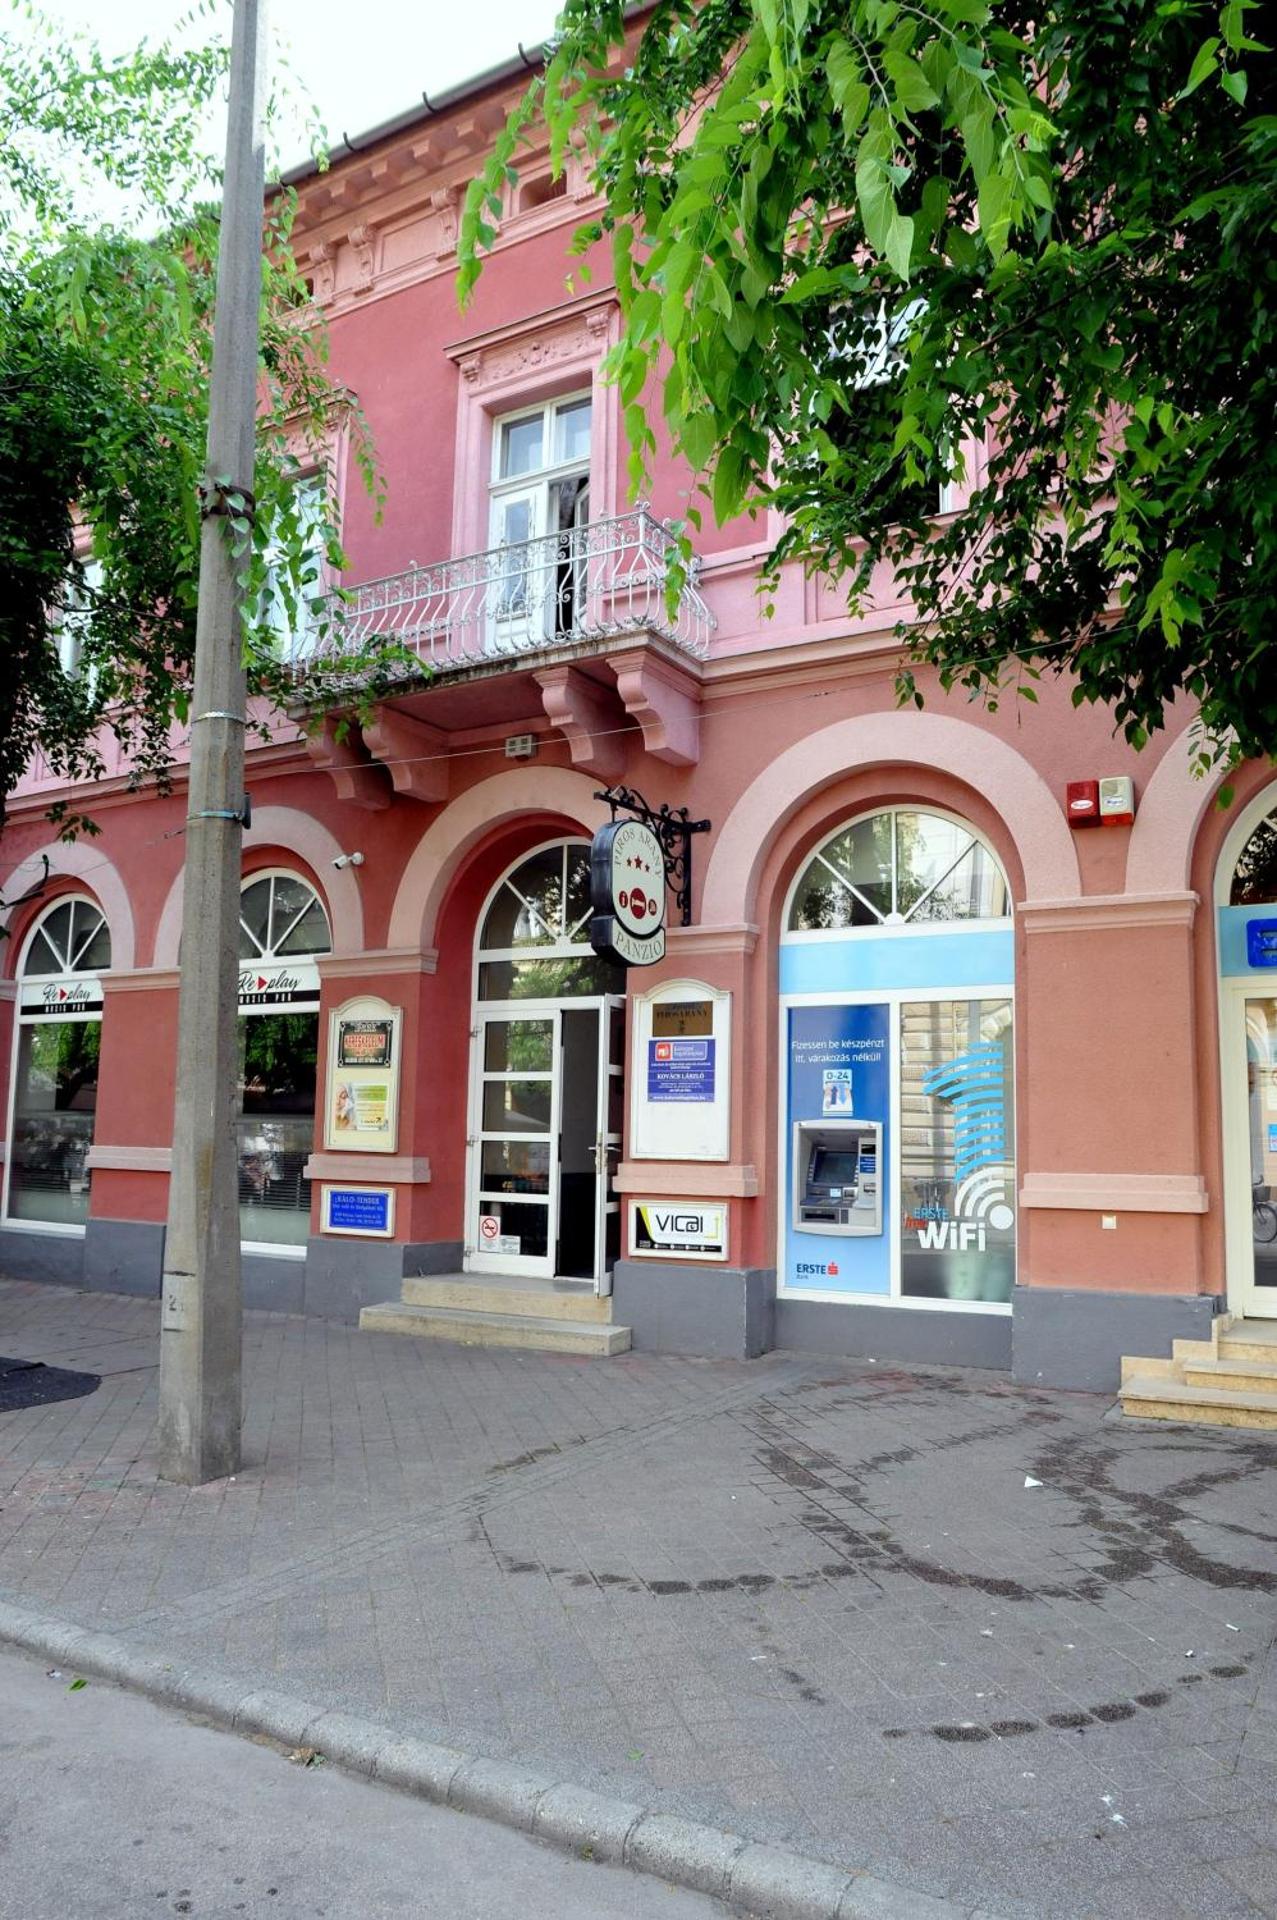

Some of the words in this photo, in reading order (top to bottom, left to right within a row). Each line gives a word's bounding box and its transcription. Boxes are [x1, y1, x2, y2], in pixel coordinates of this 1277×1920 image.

[614, 829, 635, 866] PIROS
[829, 1040, 839, 1048] be
[841, 1038, 885, 1049] készpénzt
[826, 1071, 849, 1080] 0-24
[912, 1207, 949, 1221] ERSTE
[917, 1220, 986, 1252] WiFi
[796, 1263, 827, 1275] ERSTE
